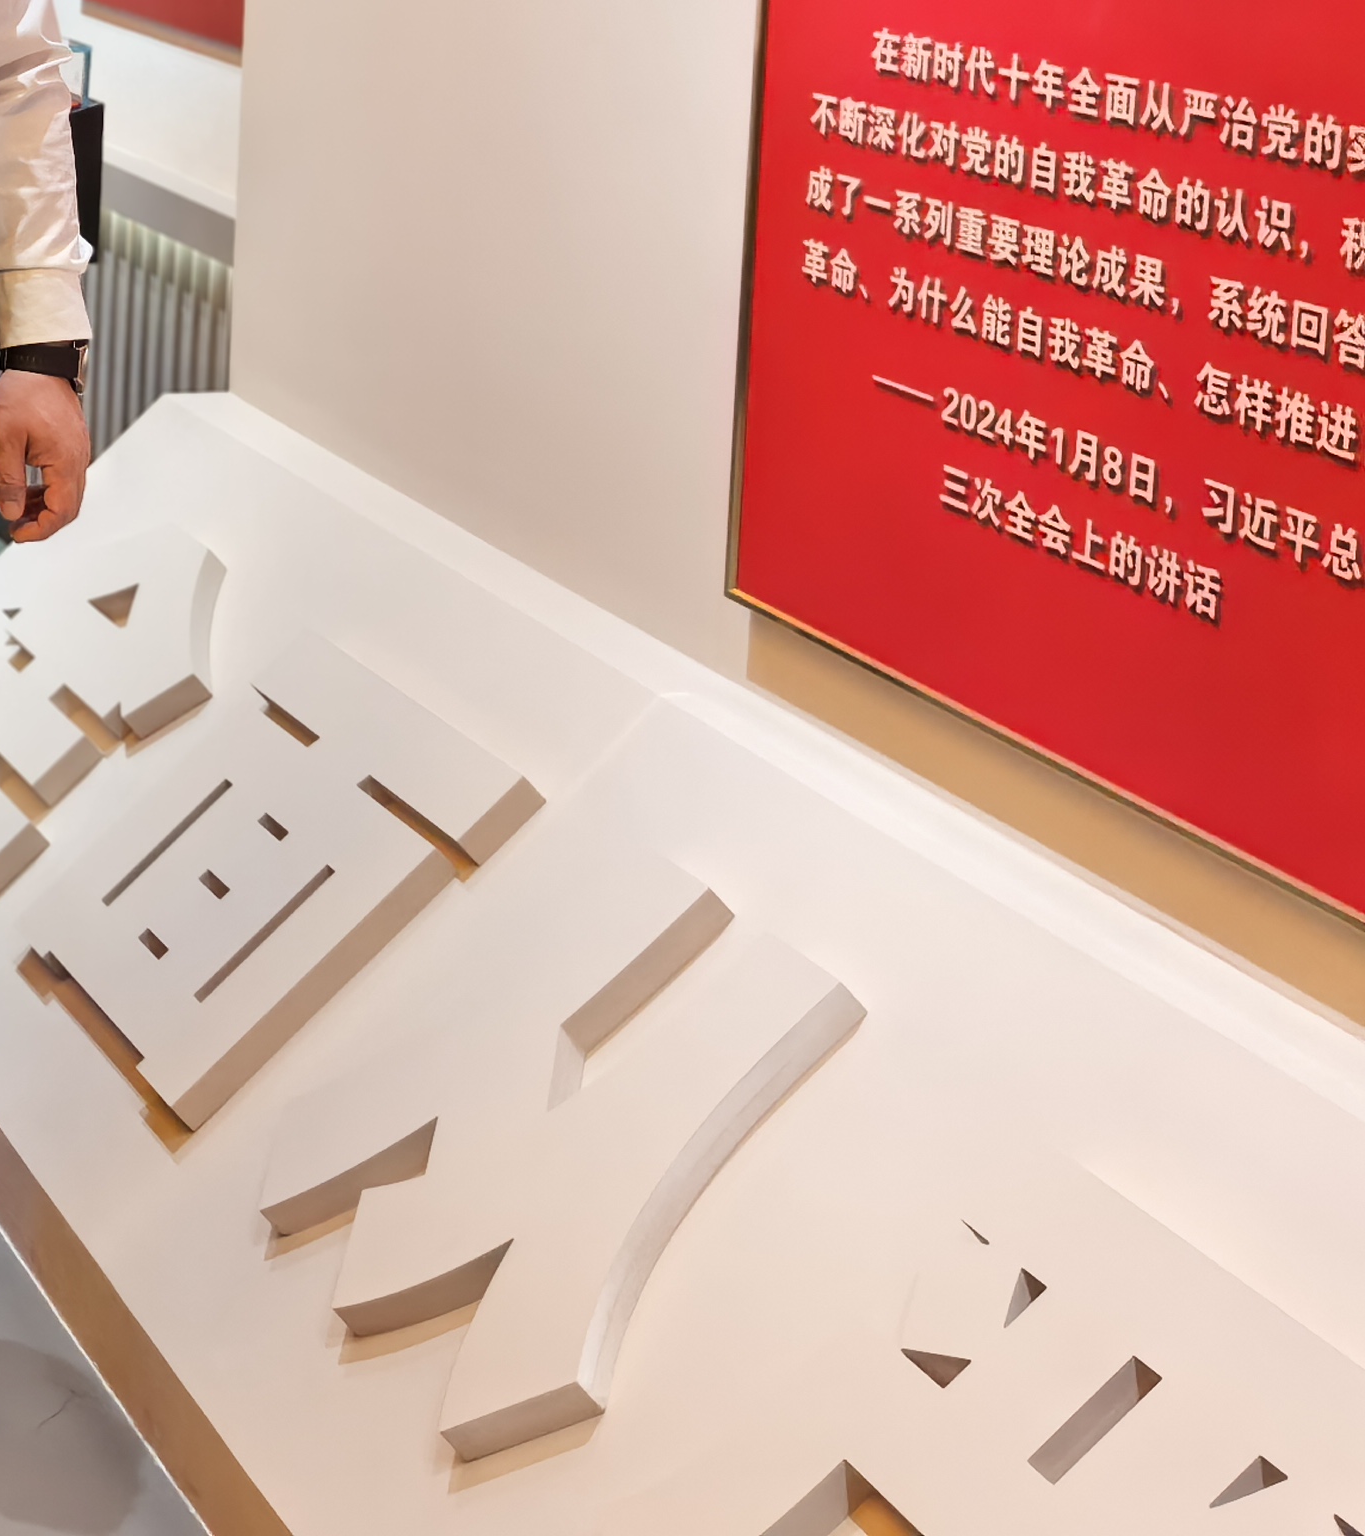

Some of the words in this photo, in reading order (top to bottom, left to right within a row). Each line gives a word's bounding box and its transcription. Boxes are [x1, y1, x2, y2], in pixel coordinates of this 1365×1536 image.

[800, 238, 1359, 464] 革命、为什么能自我革命、怎样推进
[805, 165, 1365, 370] 成了一系列重要理论成果，系统回答
[872, 373, 1363, 582] ——2024年1月8日，习近平总
[938, 464, 1222, 625] 三次全会上的讲话
